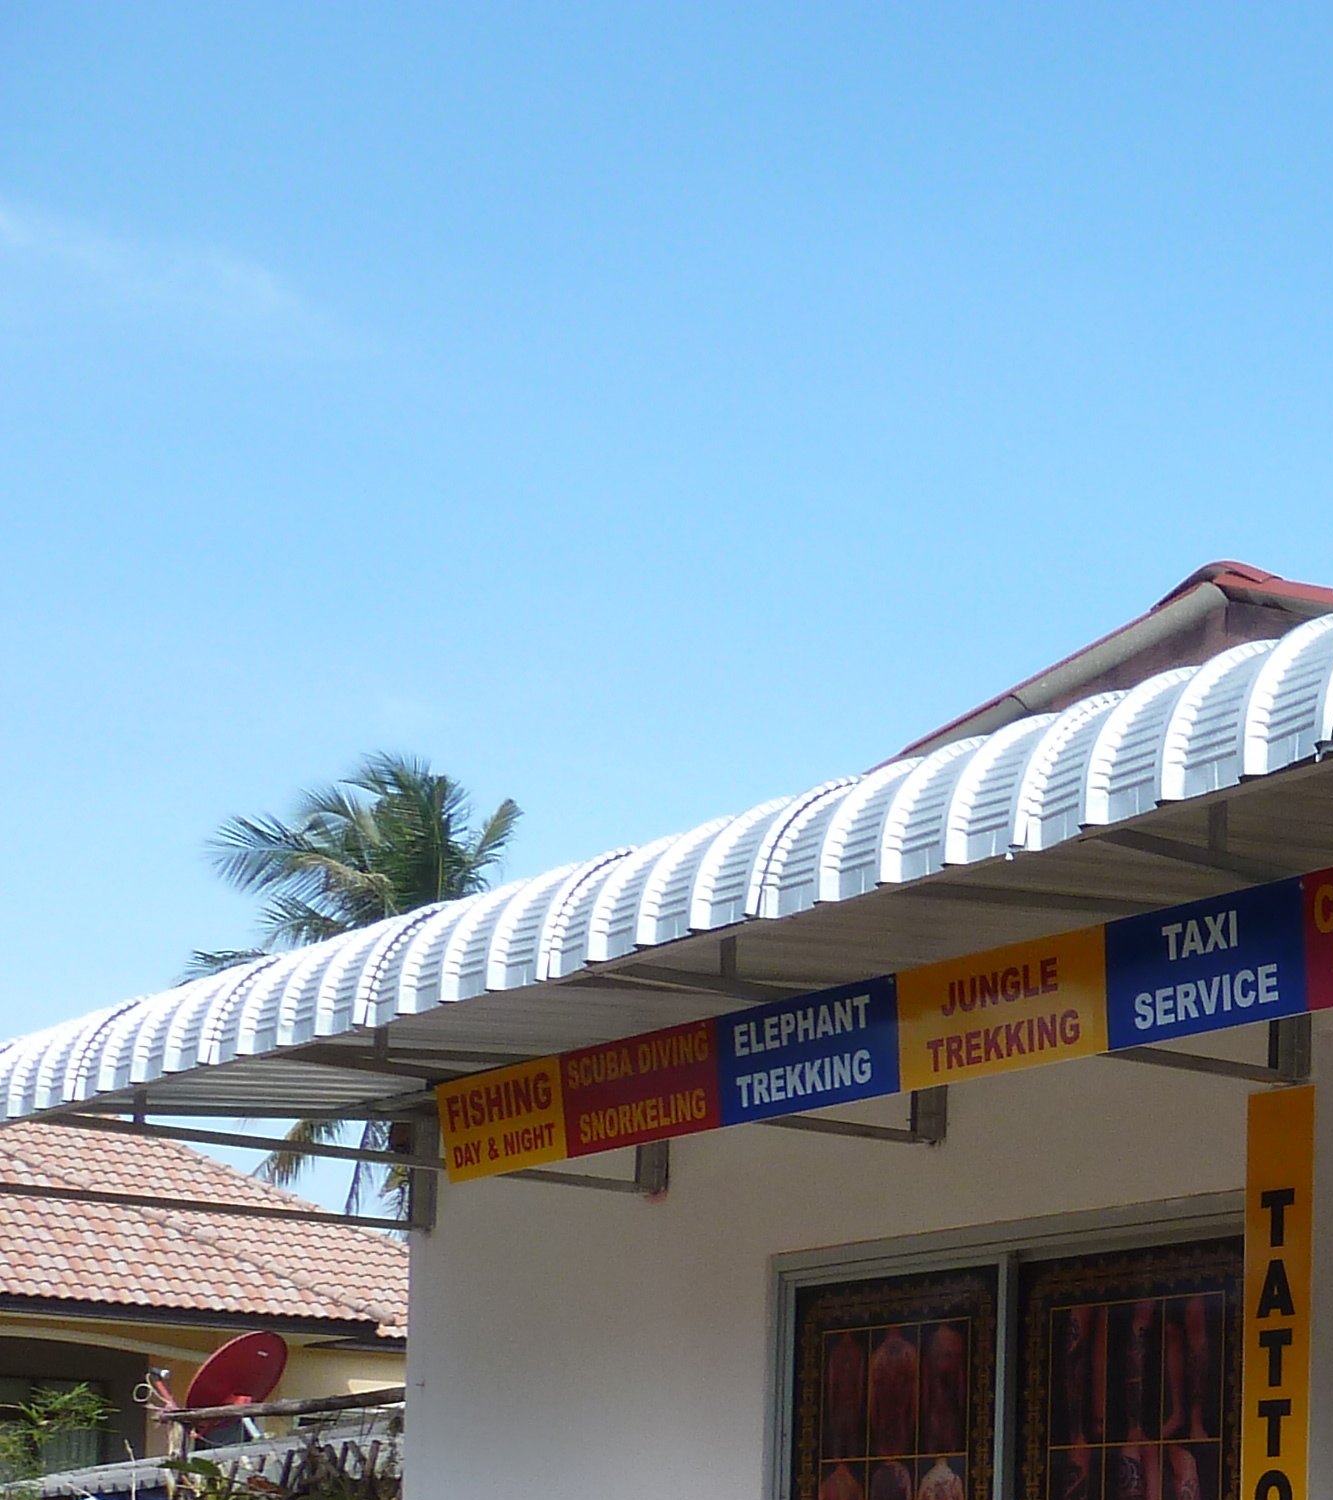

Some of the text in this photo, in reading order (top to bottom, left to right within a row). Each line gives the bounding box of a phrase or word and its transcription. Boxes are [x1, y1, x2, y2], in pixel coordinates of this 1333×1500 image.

[1161, 910, 1239, 962] TAXI
[941, 958, 1059, 1019] JUNGLE
[1133, 964, 1280, 1031] SERVICE
[733, 994, 871, 1058] ELEPHANT
[926, 1009, 1081, 1074] TREKKING
[568, 1027, 710, 1090] SCUBA DIVING
[736, 1049, 872, 1108] TREKKING
[448, 1072, 553, 1133] FISHING
[579, 1091, 708, 1146] SNORKELING
[454, 1123, 555, 1170] DAY & NIGHT
